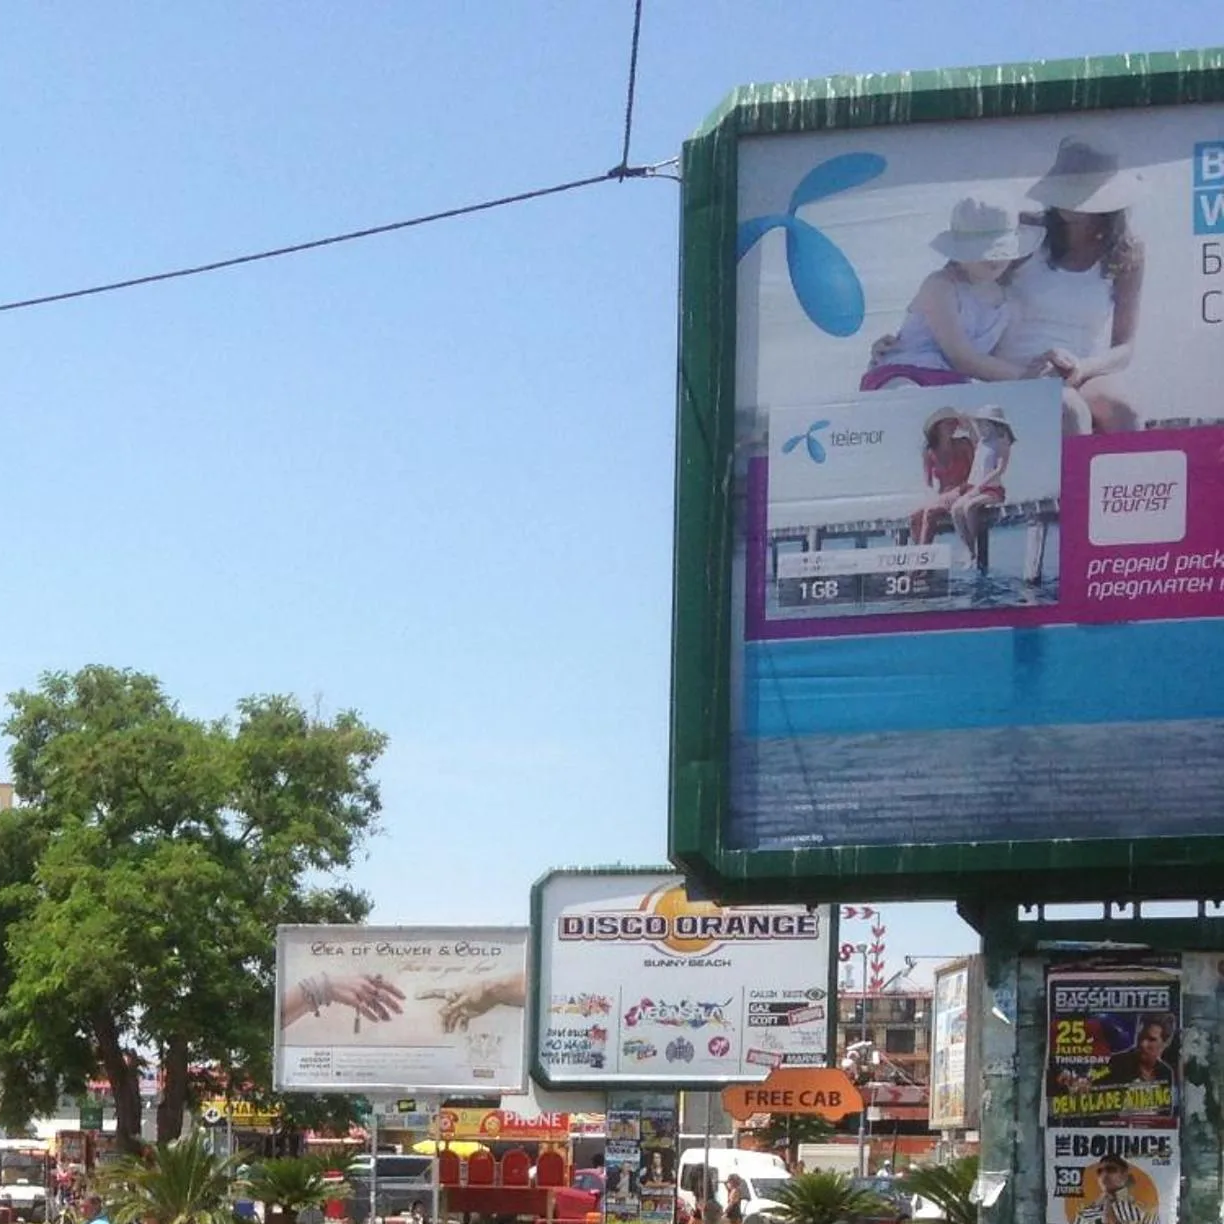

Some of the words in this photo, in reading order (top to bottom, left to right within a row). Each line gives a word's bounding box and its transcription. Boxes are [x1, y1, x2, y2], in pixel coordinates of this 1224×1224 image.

[830, 429, 885, 447] telenor
[885, 576, 911, 595] 30
[561, 914, 668, 939] DISCO
[674, 913, 820, 940] ORANGE
[438, 946, 452, 957] &
[643, 958, 687, 968] SUNNY
[688, 958, 732, 968] BEACH
[1055, 988, 1170, 1010] BASSHUNTER
[1055, 1055, 1112, 1064] THURSDAY
[744, 1090, 794, 1106] FREE
[799, 1090, 843, 1107] CAB
[503, 1111, 562, 1128] PHONE
[1073, 1134, 1171, 1158] BOUNCE
[1057, 1168, 1081, 1186] 30
